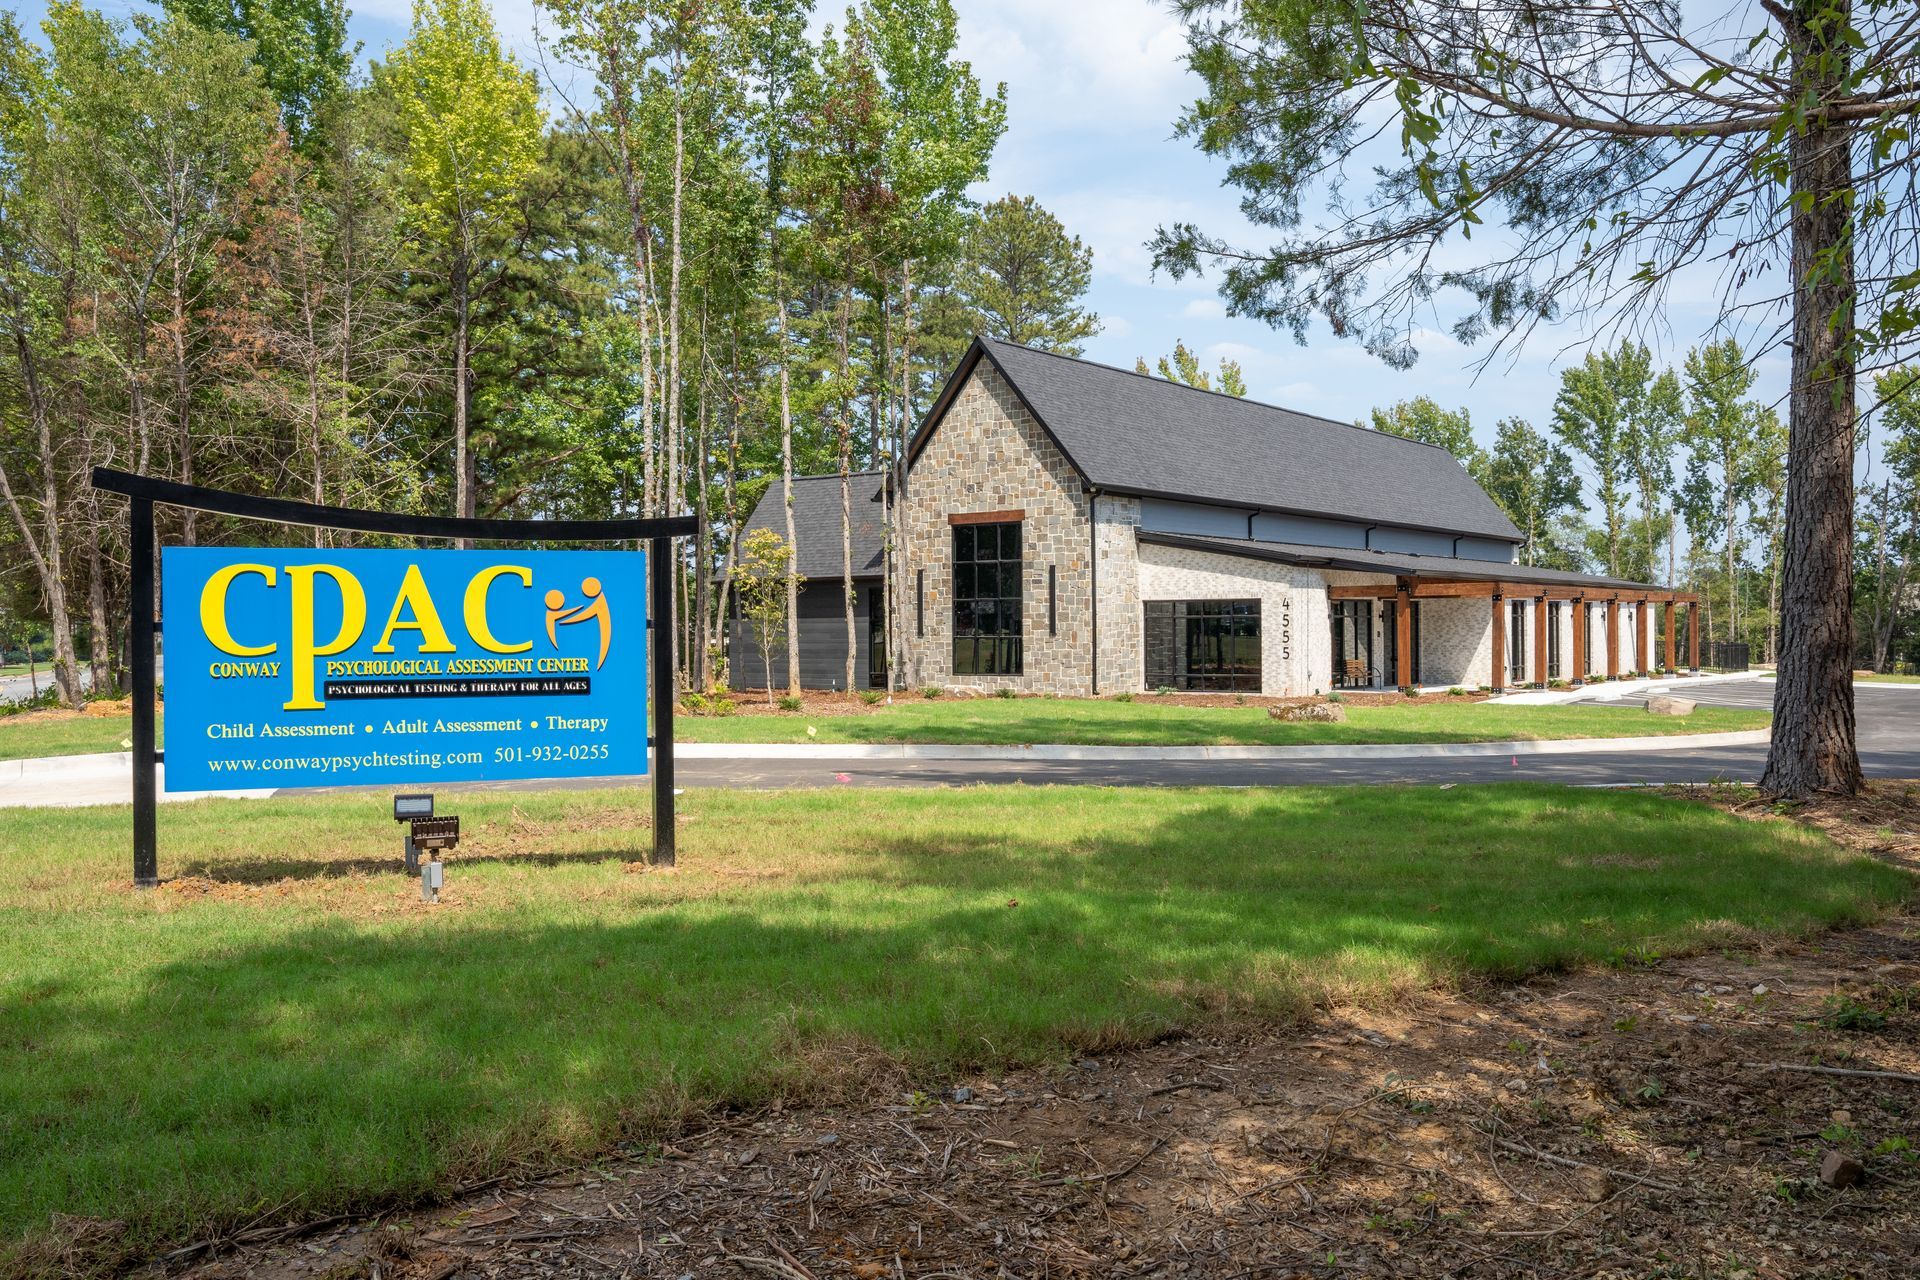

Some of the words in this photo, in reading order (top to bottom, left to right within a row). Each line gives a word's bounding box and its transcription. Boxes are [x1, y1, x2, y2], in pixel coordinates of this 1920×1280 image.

[199, 563, 534, 710] CPAC
[1282, 597, 1290, 660] 4555
[209, 662, 281, 678] CONWAY
[326, 660, 443, 676] PSYCHOLOGICAL
[446, 658, 533, 674] ASSESSMENT
[537, 657, 590, 673] CENTER
[328, 684, 411, 694] PSYCHOLOGICAL
[414, 683, 457, 693] TESTING
[459, 683, 468, 692] &
[471, 682, 518, 692] THERAPY
[521, 682, 539, 691] FOR
[542, 681, 560, 691] ALL
[563, 681, 588, 690] AGES
[206, 723, 255, 739] Child
[259, 722, 355, 738] Assessment
[382, 719, 429, 734] Adult
[433, 718, 523, 733] Assessment
[545, 716, 609, 732] Therapy
[208, 749, 483, 772] www.conwaypsychtesting.com
[494, 744, 609, 763] 501-932-0255
